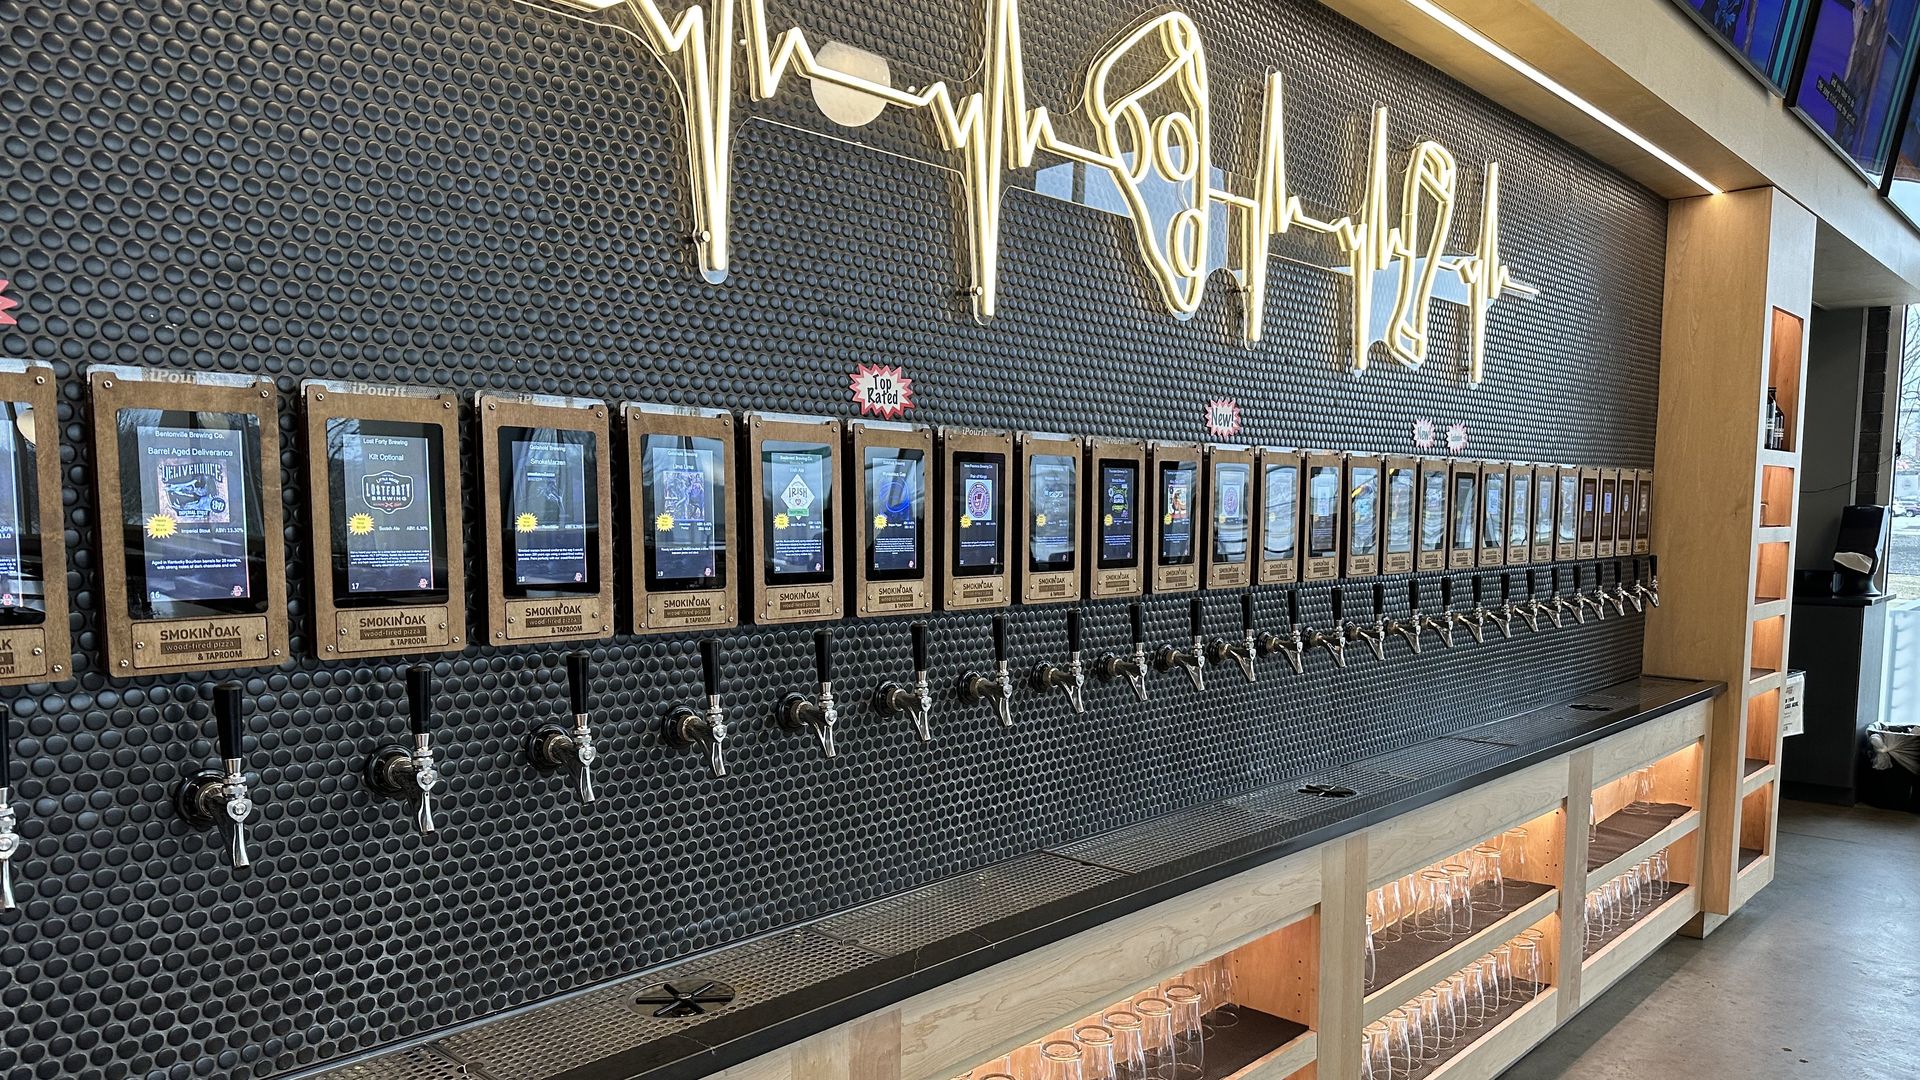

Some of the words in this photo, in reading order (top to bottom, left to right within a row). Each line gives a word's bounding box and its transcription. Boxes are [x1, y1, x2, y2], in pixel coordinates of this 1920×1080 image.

[873, 374, 892, 393] Top
[352, 381, 408, 397] iPourIt
[867, 387, 898, 405] Rated
[1211, 407, 1234, 427] New!
[155, 430, 188, 438] Bentonville
[189, 431, 213, 439] Brewing
[374, 438, 388, 446] Forty
[388, 439, 408, 447] Brewing
[147, 446, 170, 455] Barrel
[171, 447, 191, 457] Aged
[192, 448, 233, 457] Deliverance
[380, 453, 404, 461] Optional
[789, 487, 808, 498] IRISH
[150, 591, 160, 599] 16
[557, 625, 583, 633] TAPROOM
[213, 641, 234, 650] pizza
[396, 637, 427, 645] TAPROOM
[197, 652, 204, 660] &
[206, 650, 243, 660] TAPROOM
